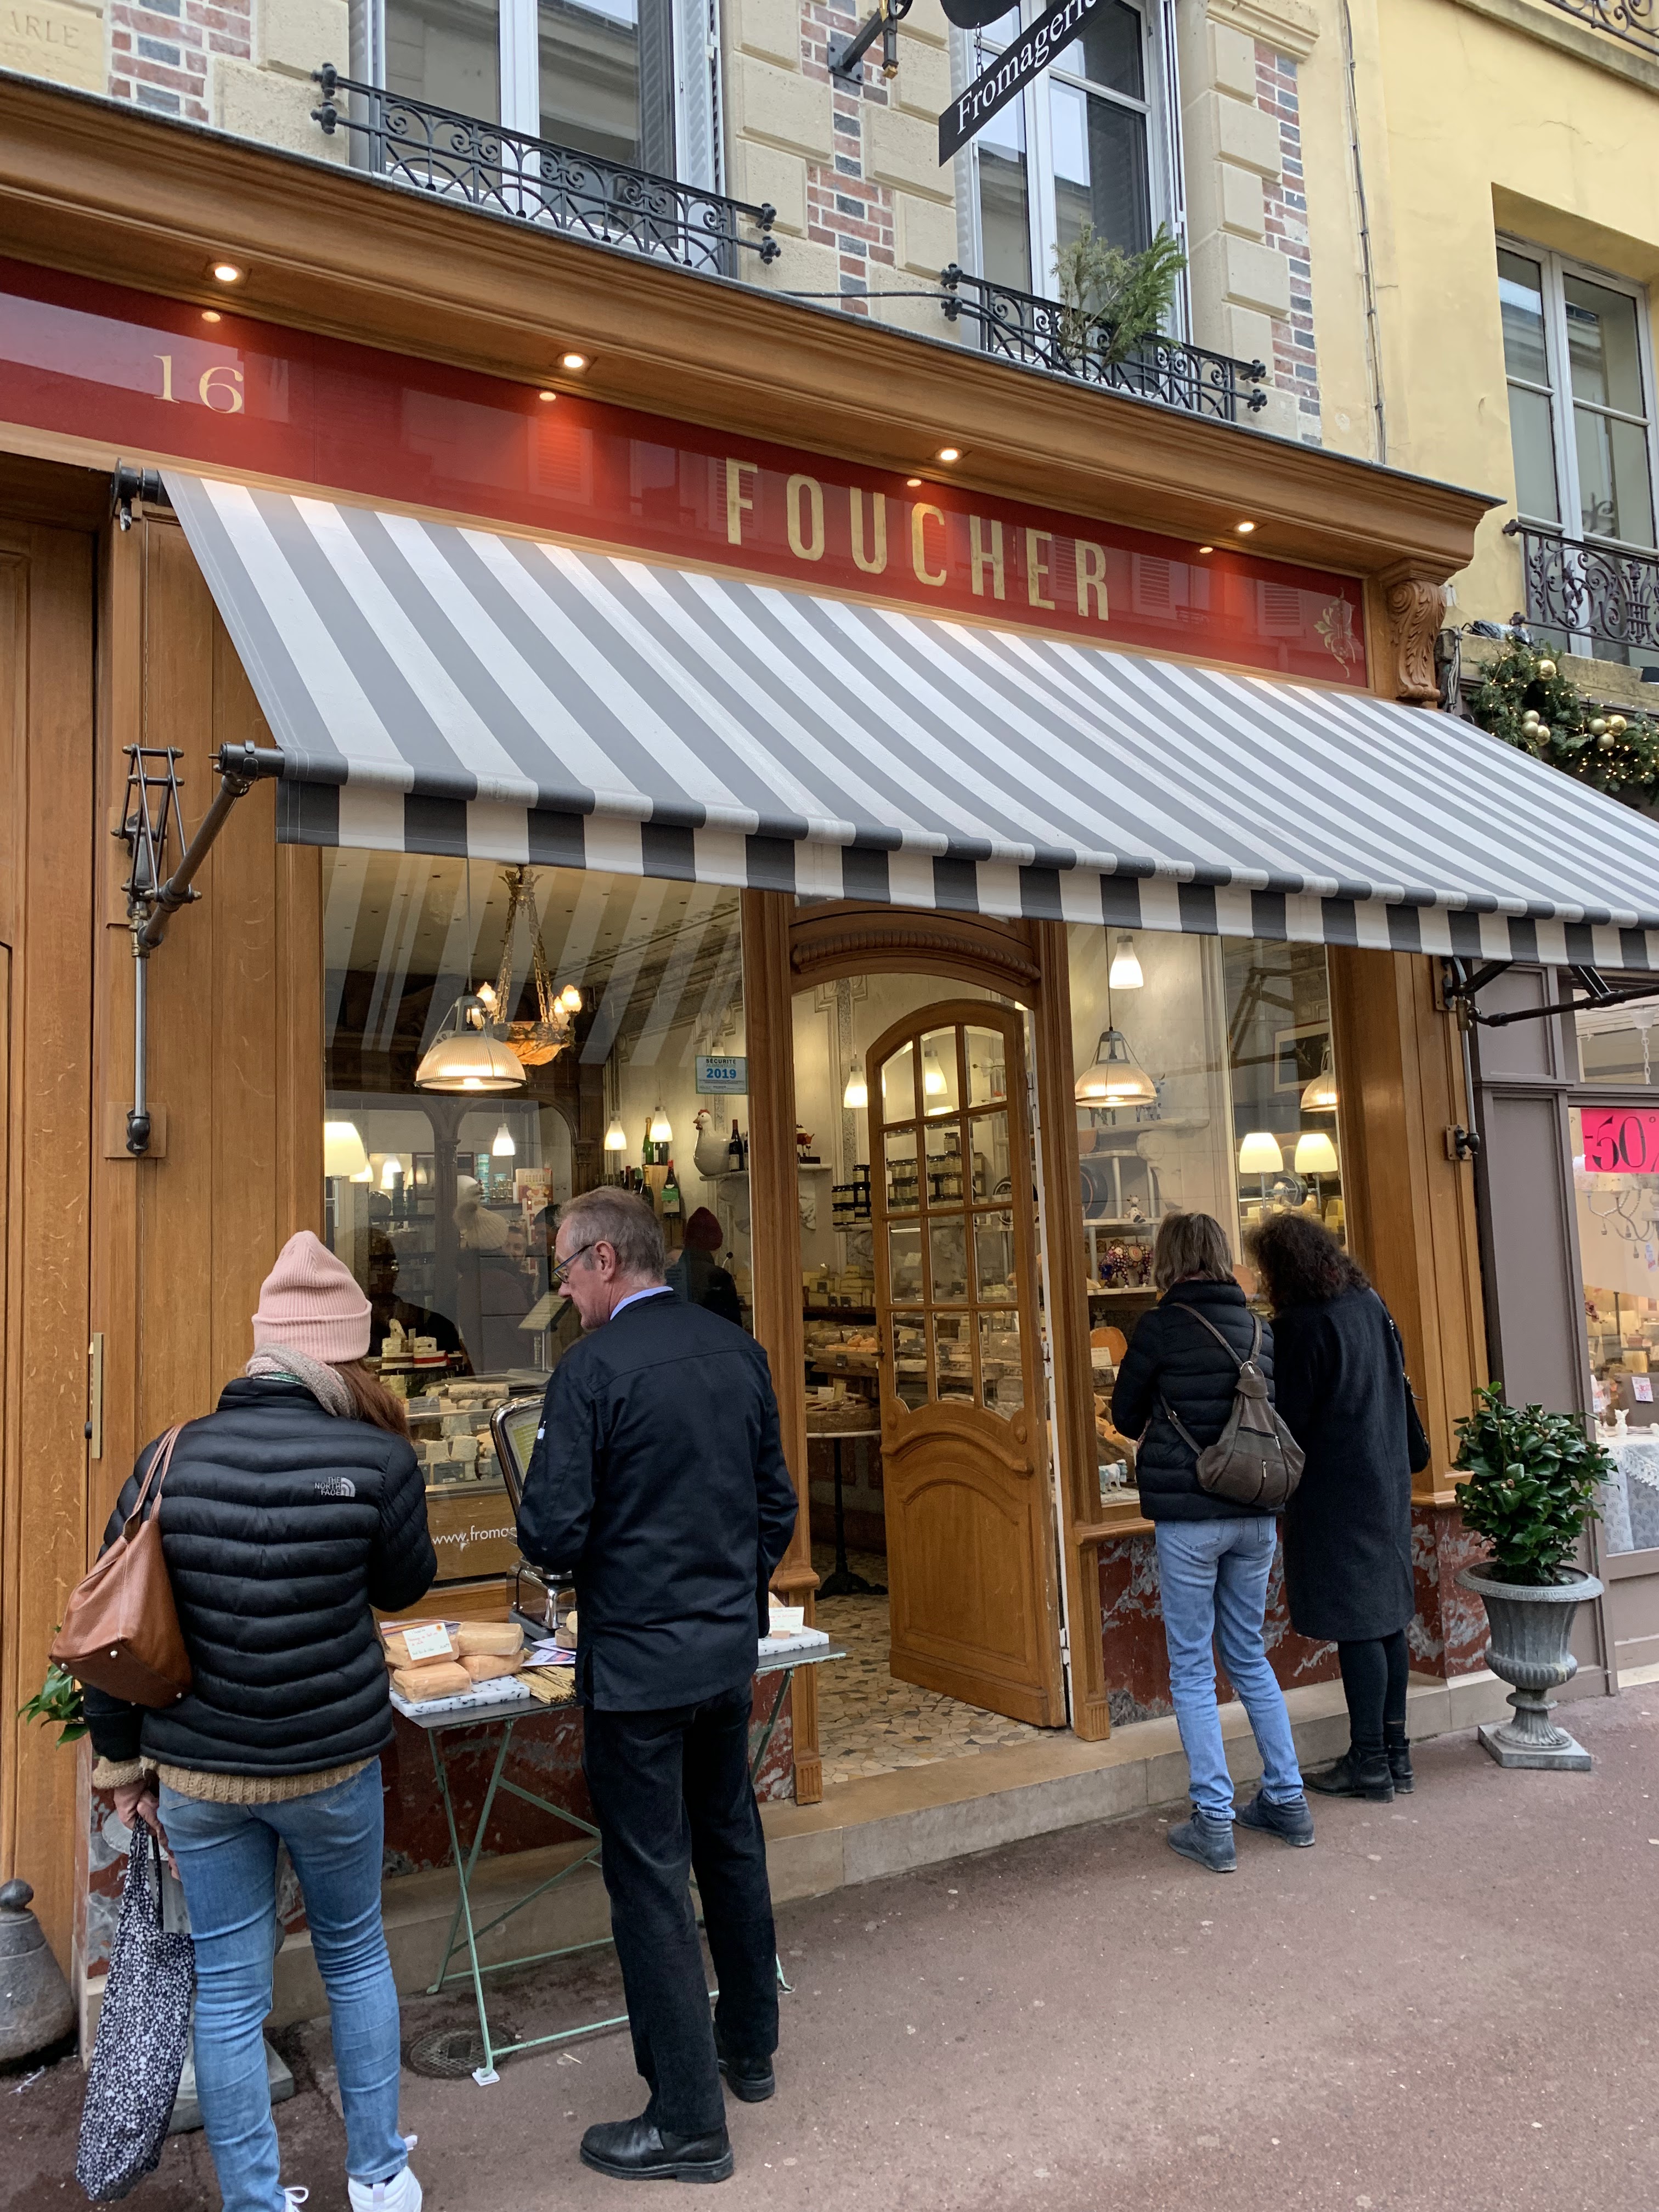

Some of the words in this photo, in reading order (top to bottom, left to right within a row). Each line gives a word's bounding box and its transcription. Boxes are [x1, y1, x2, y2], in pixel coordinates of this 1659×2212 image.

[957, 0, 1097, 136] Fromageri
[153, 354, 244, 414] 16
[725, 457, 1109, 621] FOUCHER
[706, 1068, 737, 1079] 2019
